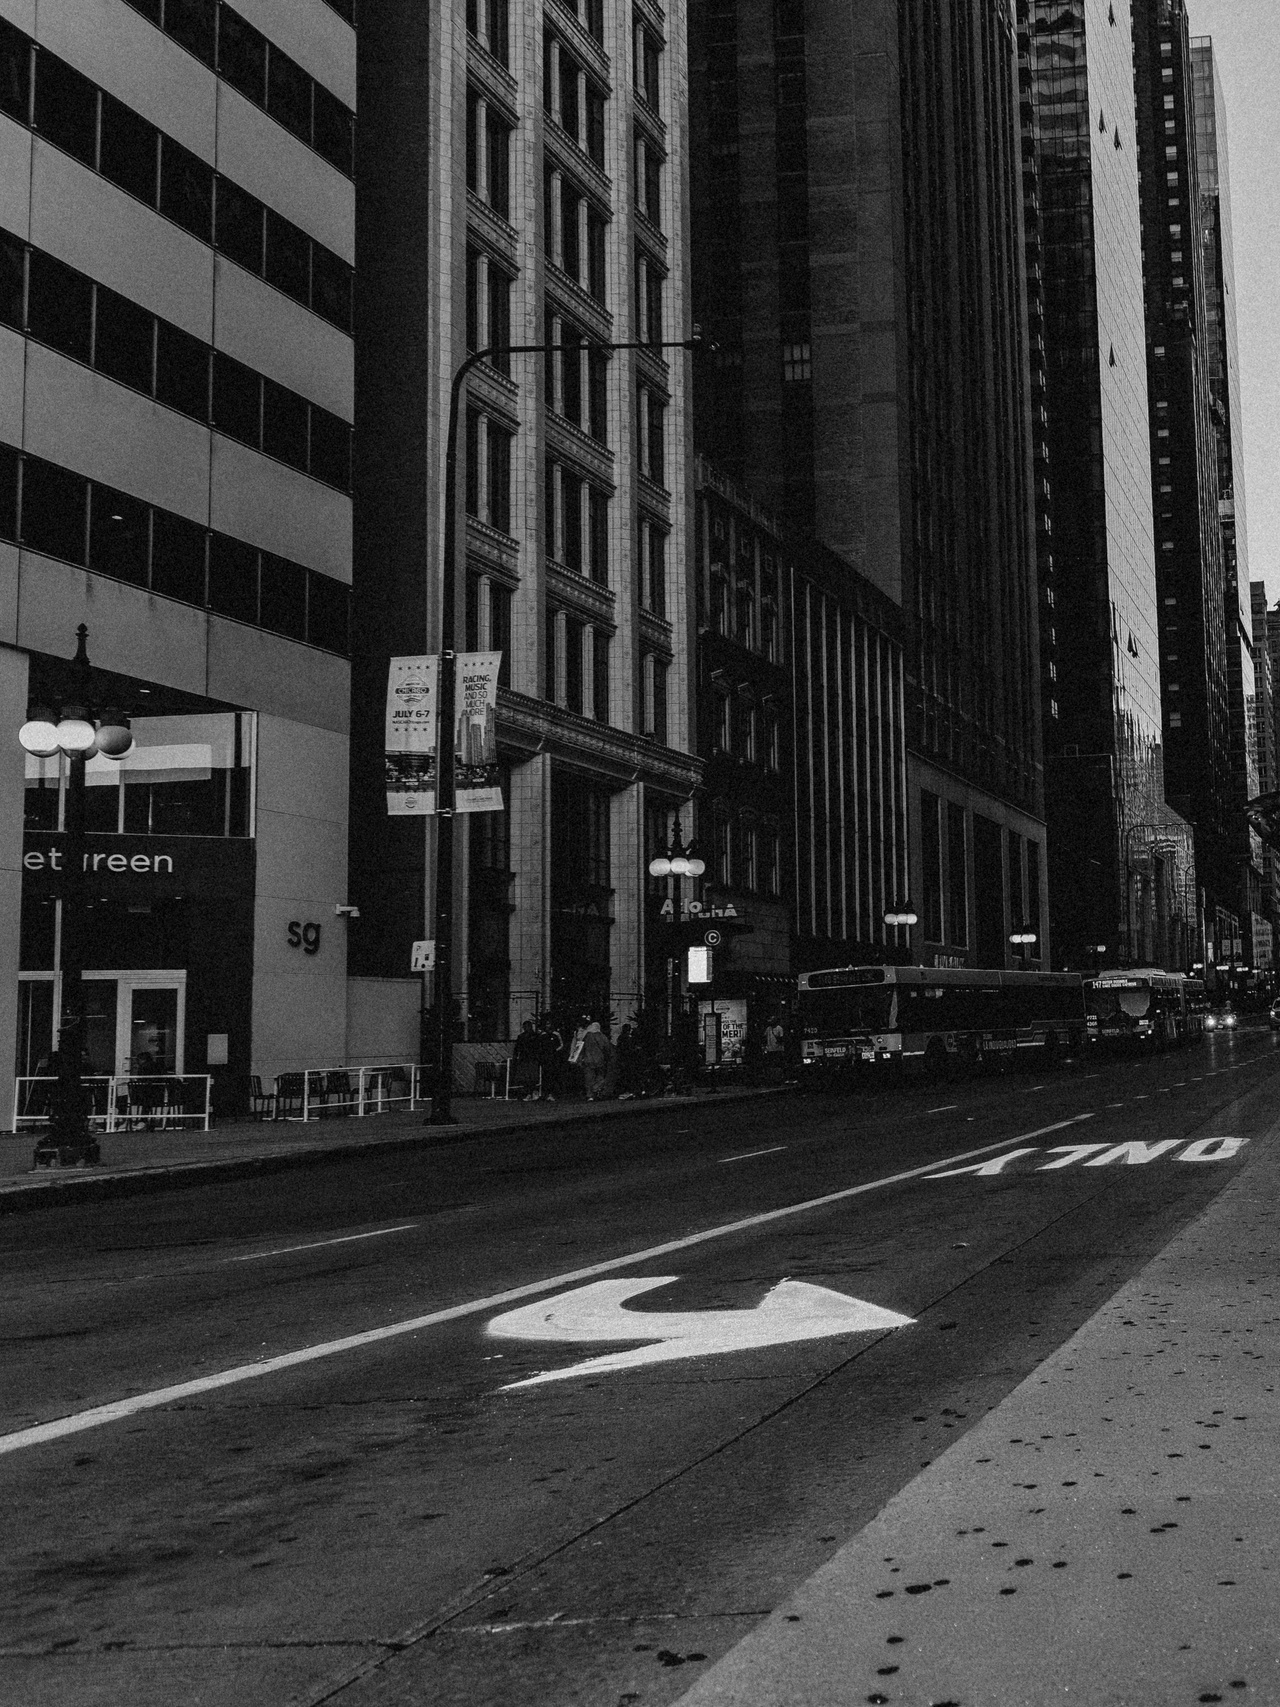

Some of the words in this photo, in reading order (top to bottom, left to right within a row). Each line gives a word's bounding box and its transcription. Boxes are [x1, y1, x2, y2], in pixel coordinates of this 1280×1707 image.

[463, 675, 491, 684] RACING,
[465, 683, 487, 691] MUSIC
[392, 710, 413, 718] JULY
[416, 710, 430, 718] 6-7
[287, 921, 321, 955] sg
[921, 1137, 1250, 1179] ONLY
